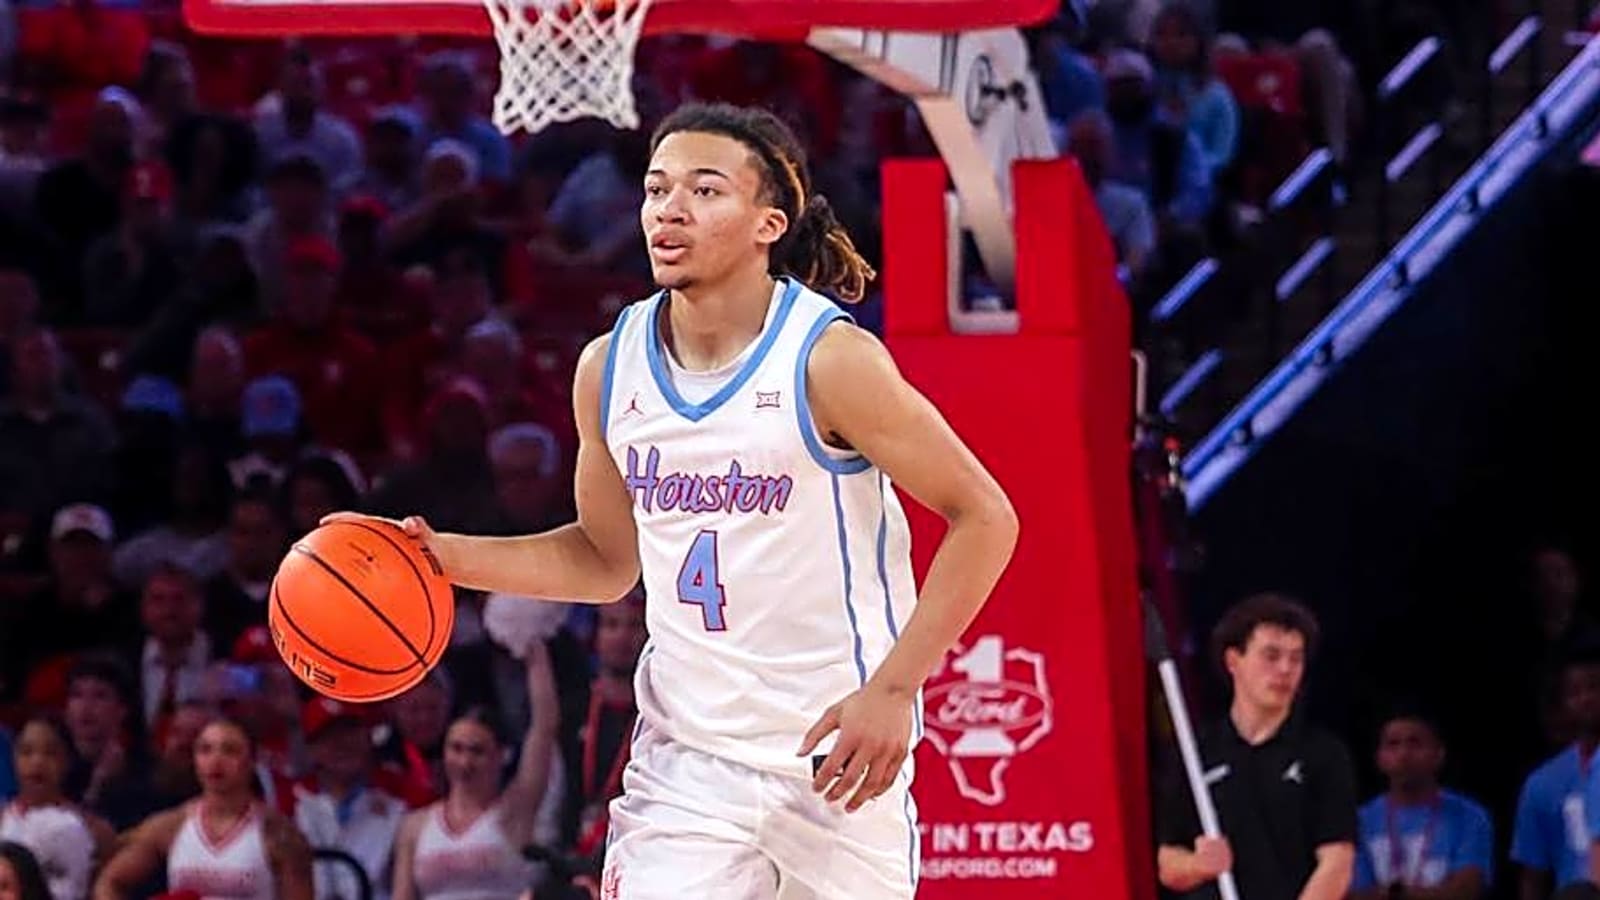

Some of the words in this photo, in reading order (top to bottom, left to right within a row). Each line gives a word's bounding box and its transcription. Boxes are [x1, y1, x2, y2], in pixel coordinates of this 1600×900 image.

[625, 445, 793, 516] Houston
[676, 529, 727, 631] 4
[938, 682, 1028, 725] Ford
[933, 821, 969, 851] IN
[974, 820, 1094, 853] TEXAS
